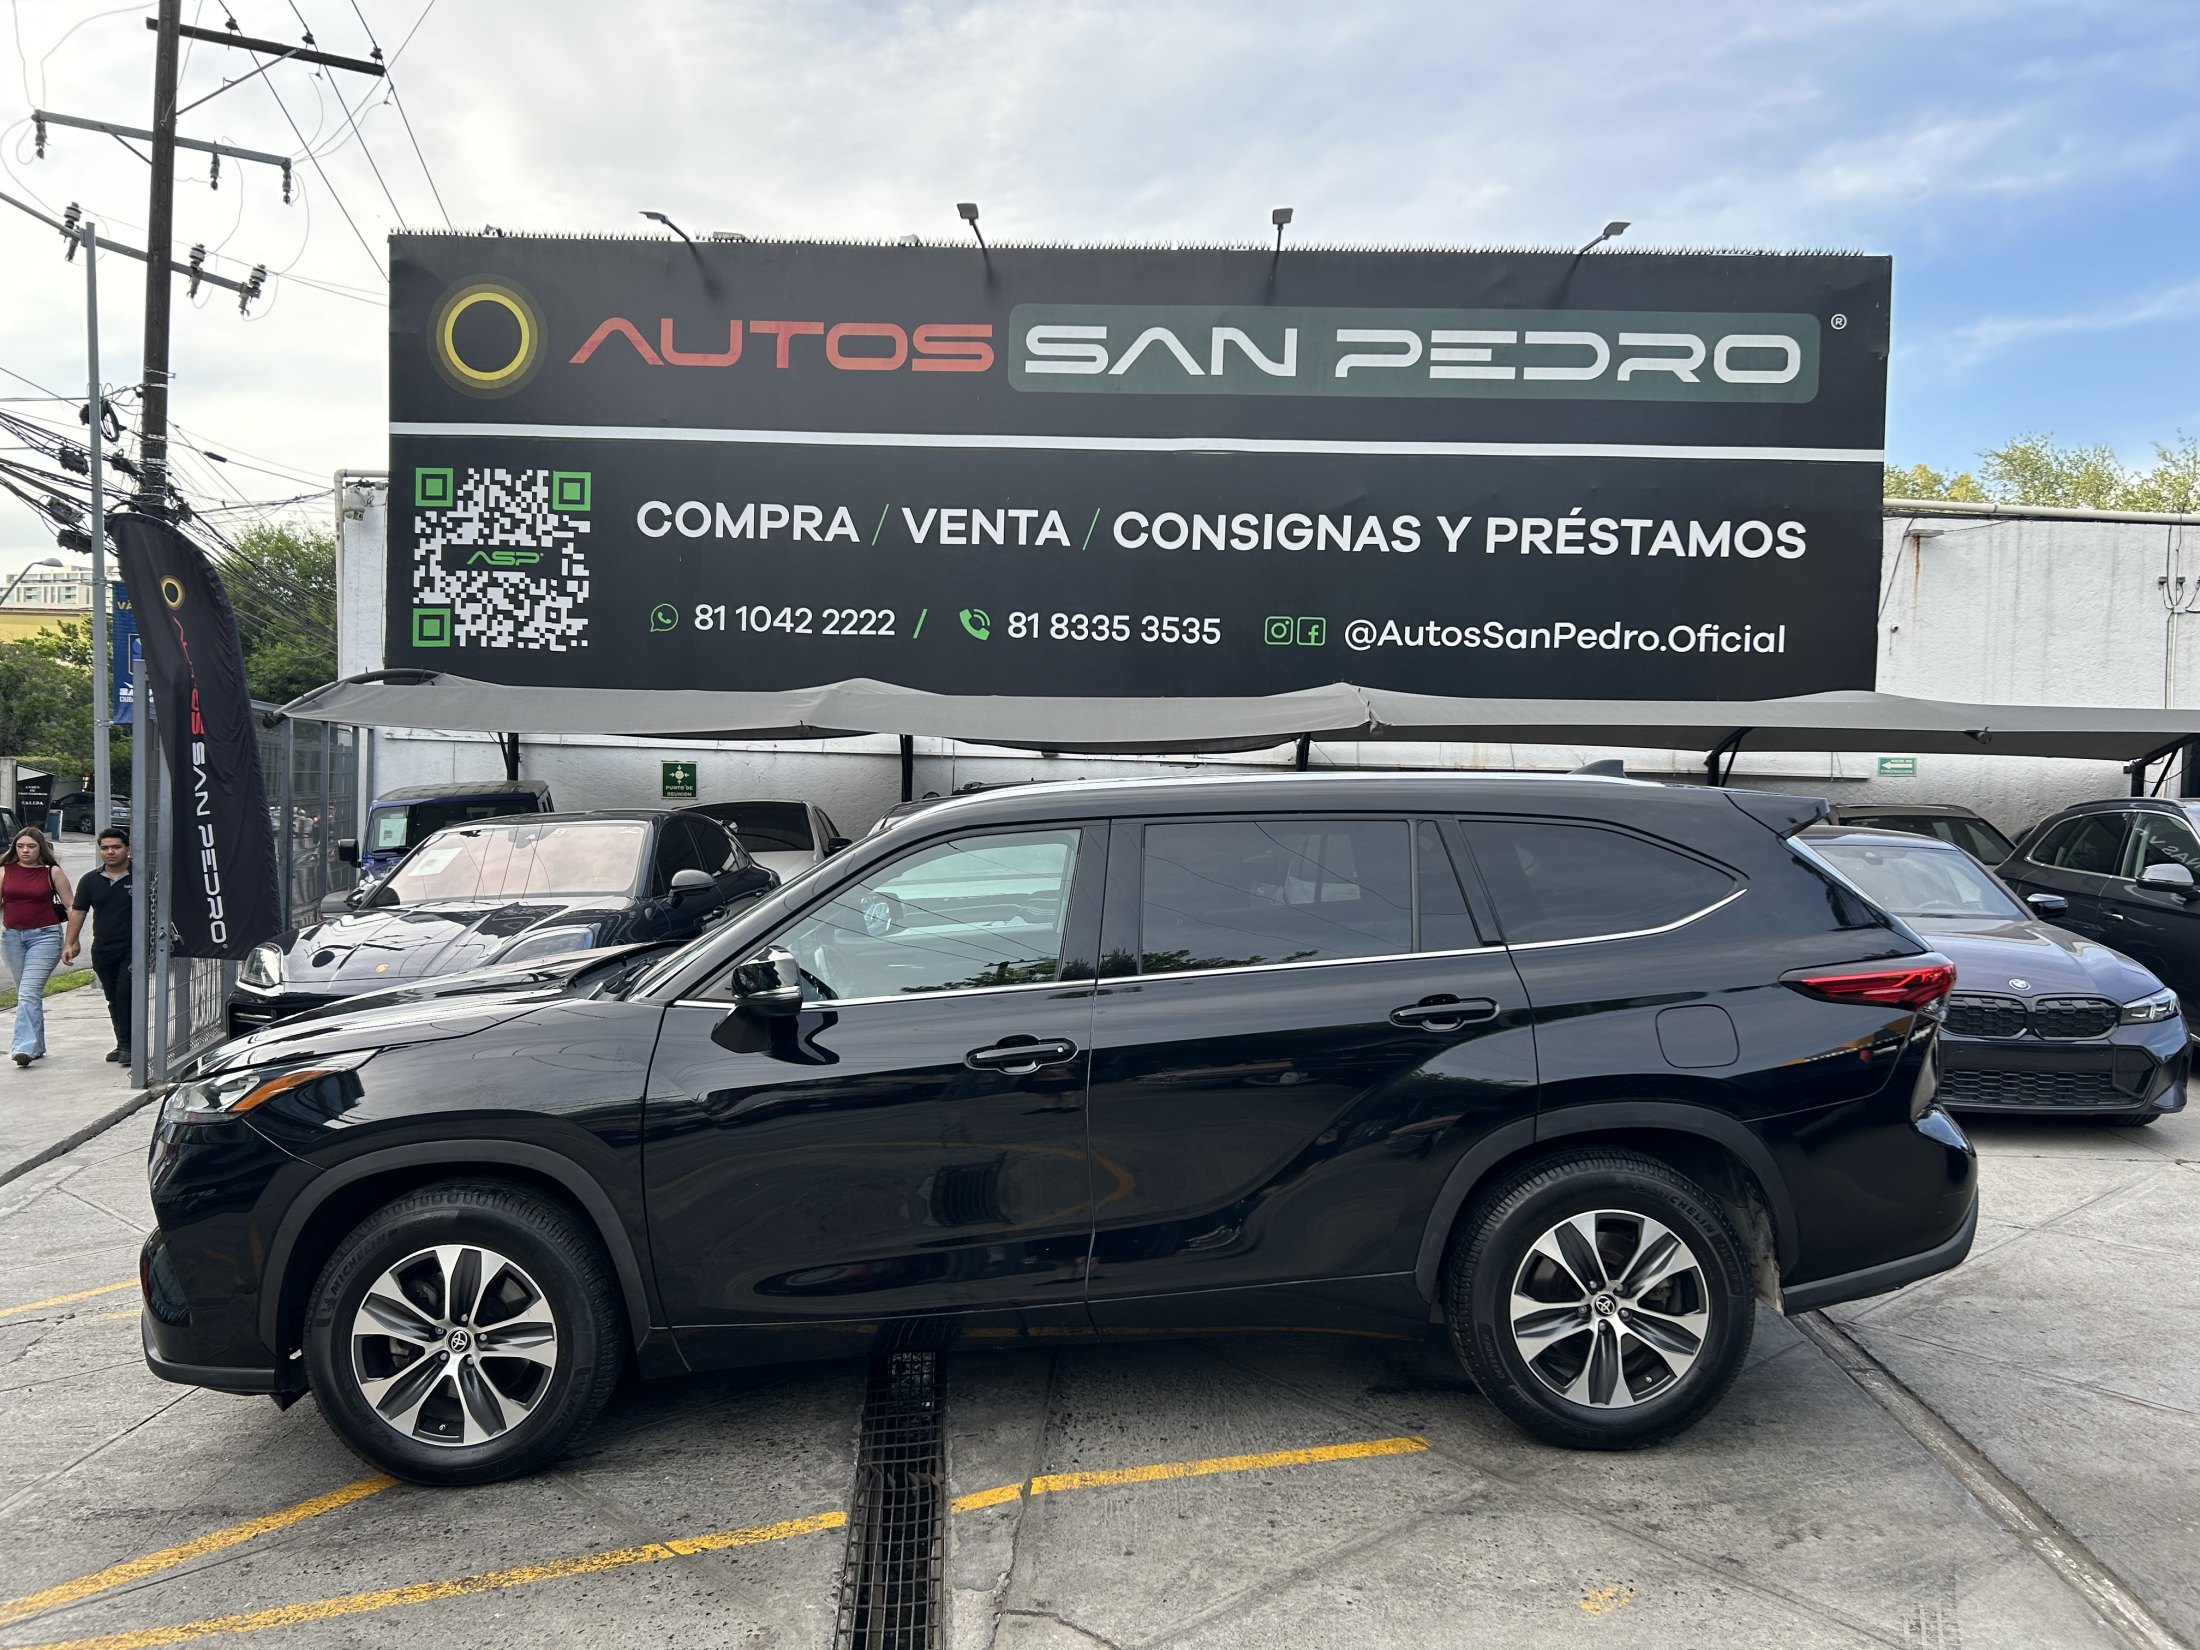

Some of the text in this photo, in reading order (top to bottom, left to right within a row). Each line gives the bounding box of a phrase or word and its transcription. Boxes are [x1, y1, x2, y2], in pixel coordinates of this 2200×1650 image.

[570, 316, 995, 372] AUTOS
[1025, 325, 1298, 377] SAN
[1334, 329, 1802, 384] PEDRO
[636, 500, 861, 543] COMPRA
[900, 506, 1070, 547] VENTA
[1112, 510, 1422, 553] CONSIGNAS
[1436, 515, 1472, 553] Y
[1485, 506, 1807, 560] PRÉSTAMOS
[466, 550, 540, 566] ASP
[694, 603, 726, 631] 81
[735, 605, 813, 634] 1042
[821, 608, 896, 636] 2222
[1007, 611, 1221, 645] 81 8335 3535
[1344, 619, 1786, 653] @AutosSanPedro.Oficial
[191, 741, 227, 945] SAN PEDRO
